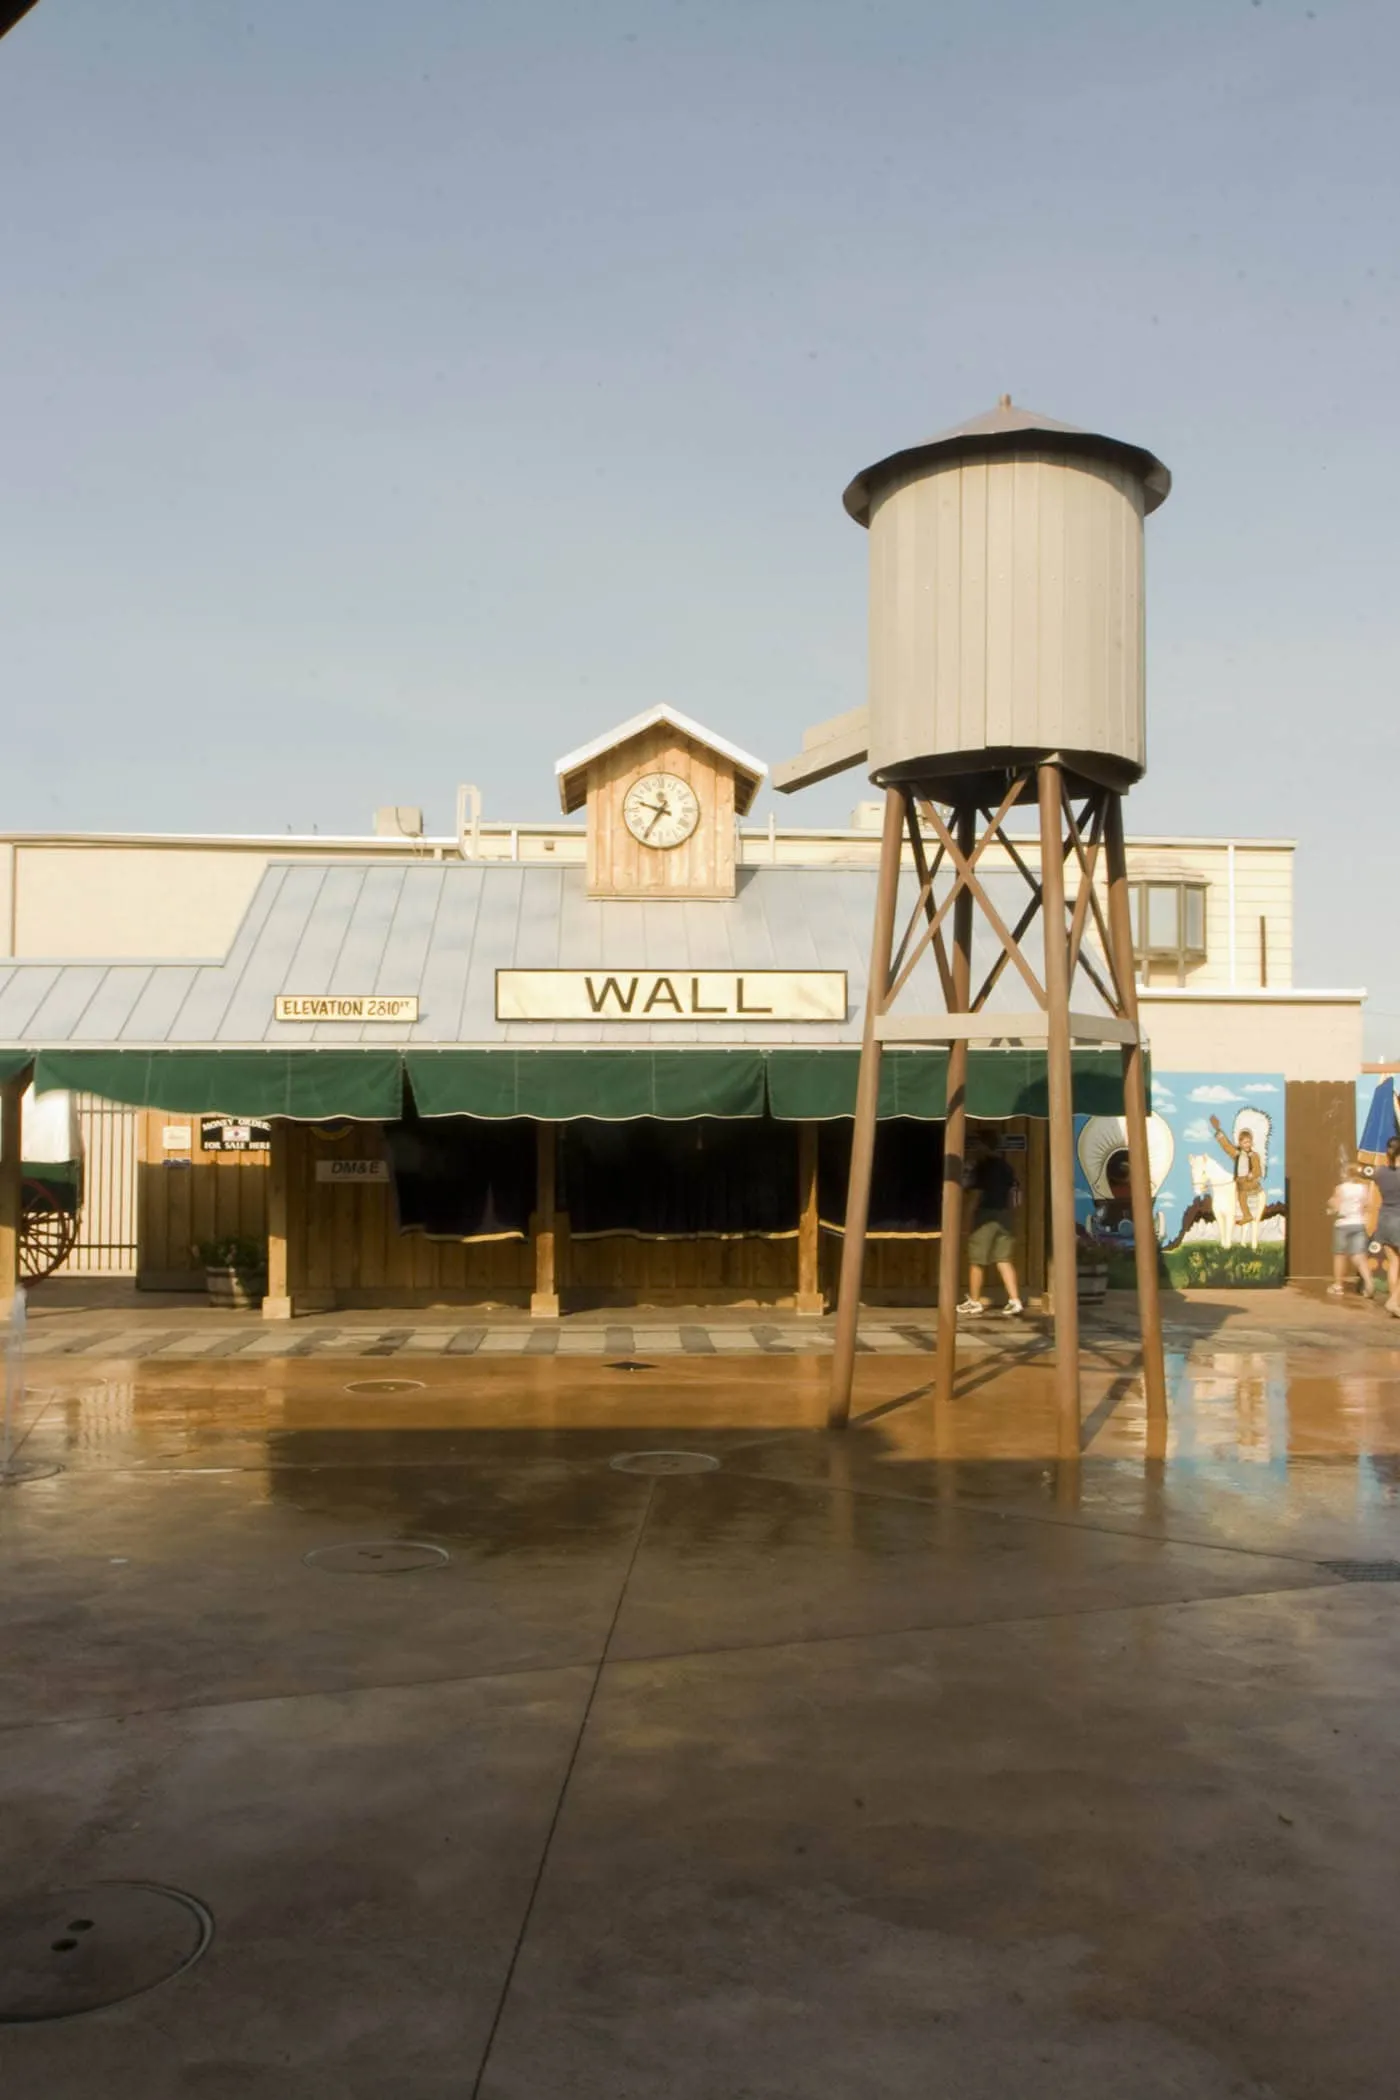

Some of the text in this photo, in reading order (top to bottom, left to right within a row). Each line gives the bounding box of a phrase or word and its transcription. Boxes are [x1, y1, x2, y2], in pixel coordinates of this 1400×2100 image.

[584, 977, 773, 1014] WALL
[283, 1000, 363, 1016] ELEVATION
[202, 1119, 234, 1131] MONEY
